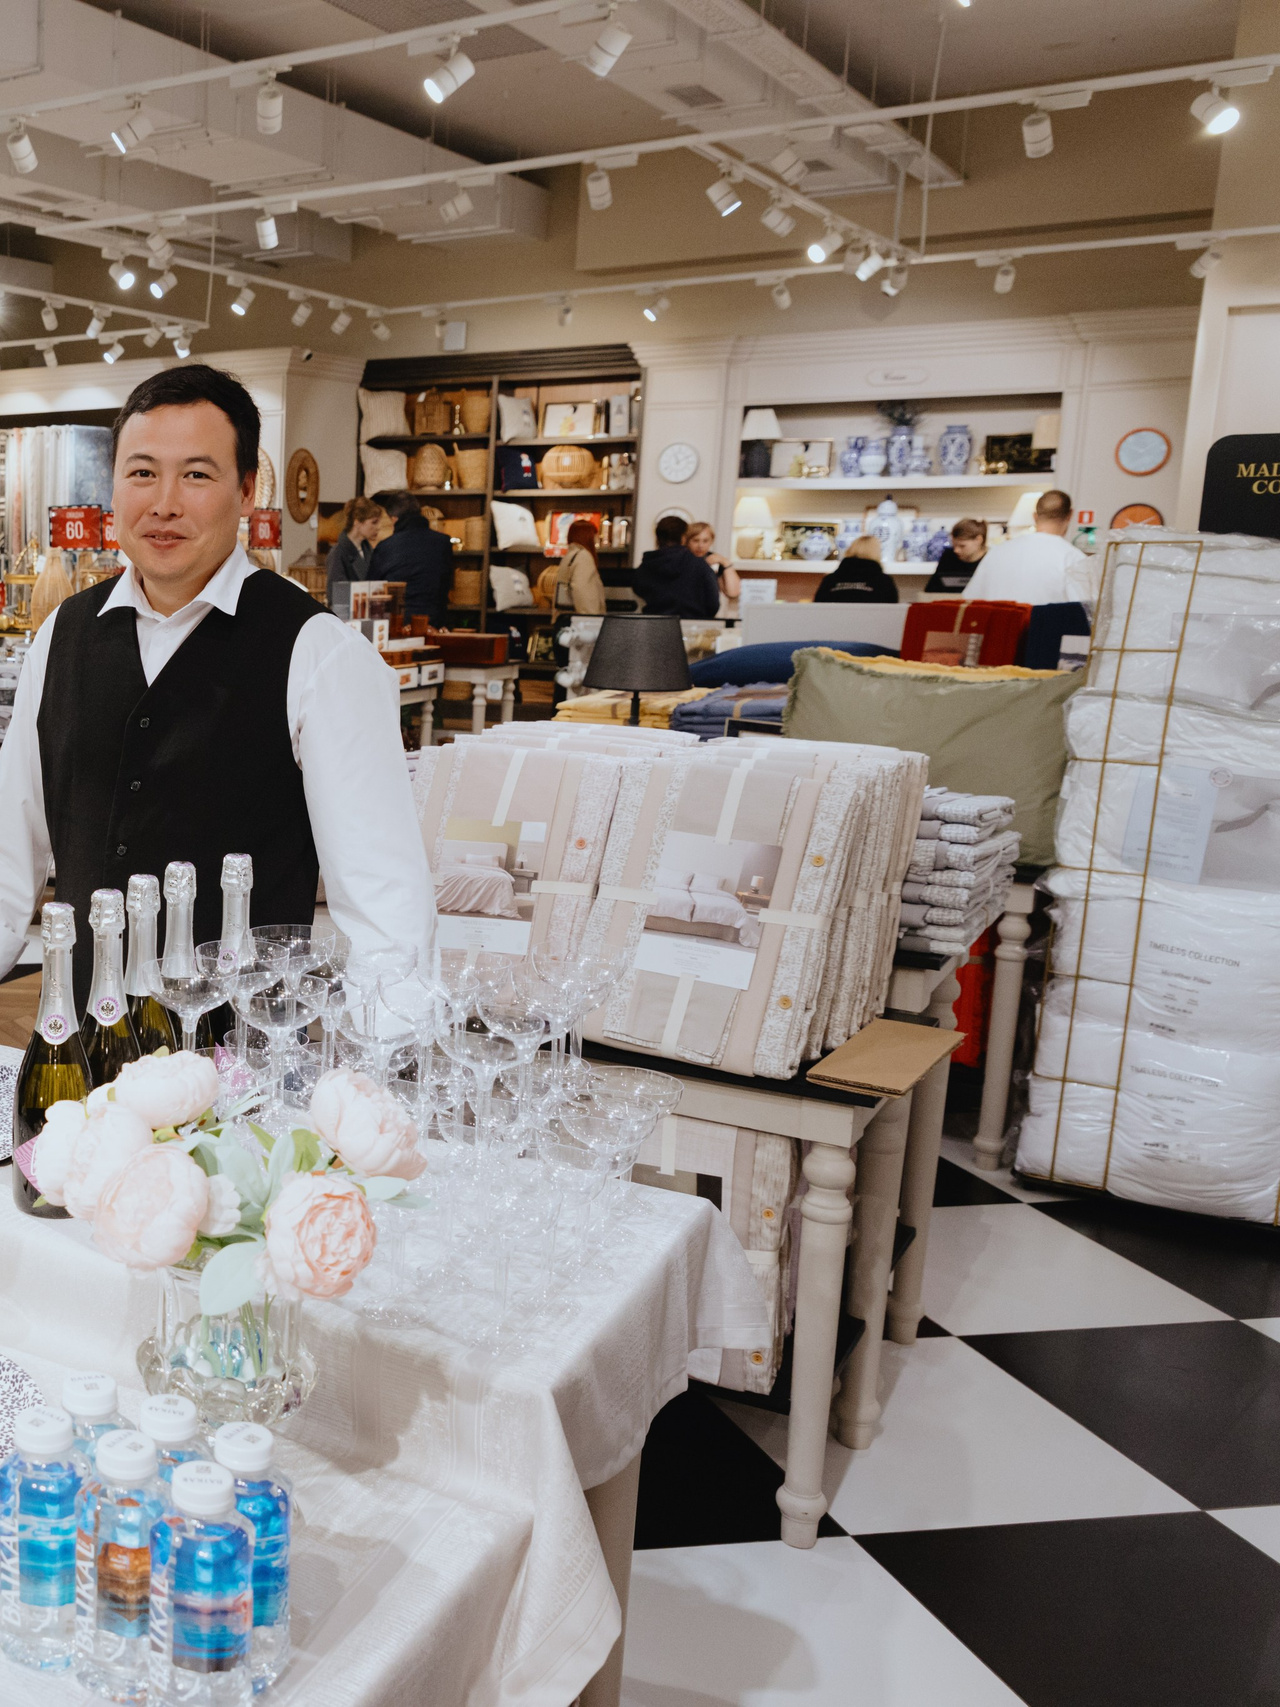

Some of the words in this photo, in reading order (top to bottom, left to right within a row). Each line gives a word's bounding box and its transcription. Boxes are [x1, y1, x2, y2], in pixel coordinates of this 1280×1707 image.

[1149, 941, 1187, 957] TIMELESS
[1188, 950, 1240, 968] COLLECTION
[1130, 1065, 1168, 1079] TIMELESS
[1170, 1071, 1219, 1088] COLLECTION
[0, 1518, 20, 1627] BAIKAL
[75, 1542, 95, 1655] BAIKAL
[149, 1576, 170, 1693] BAIKAL
